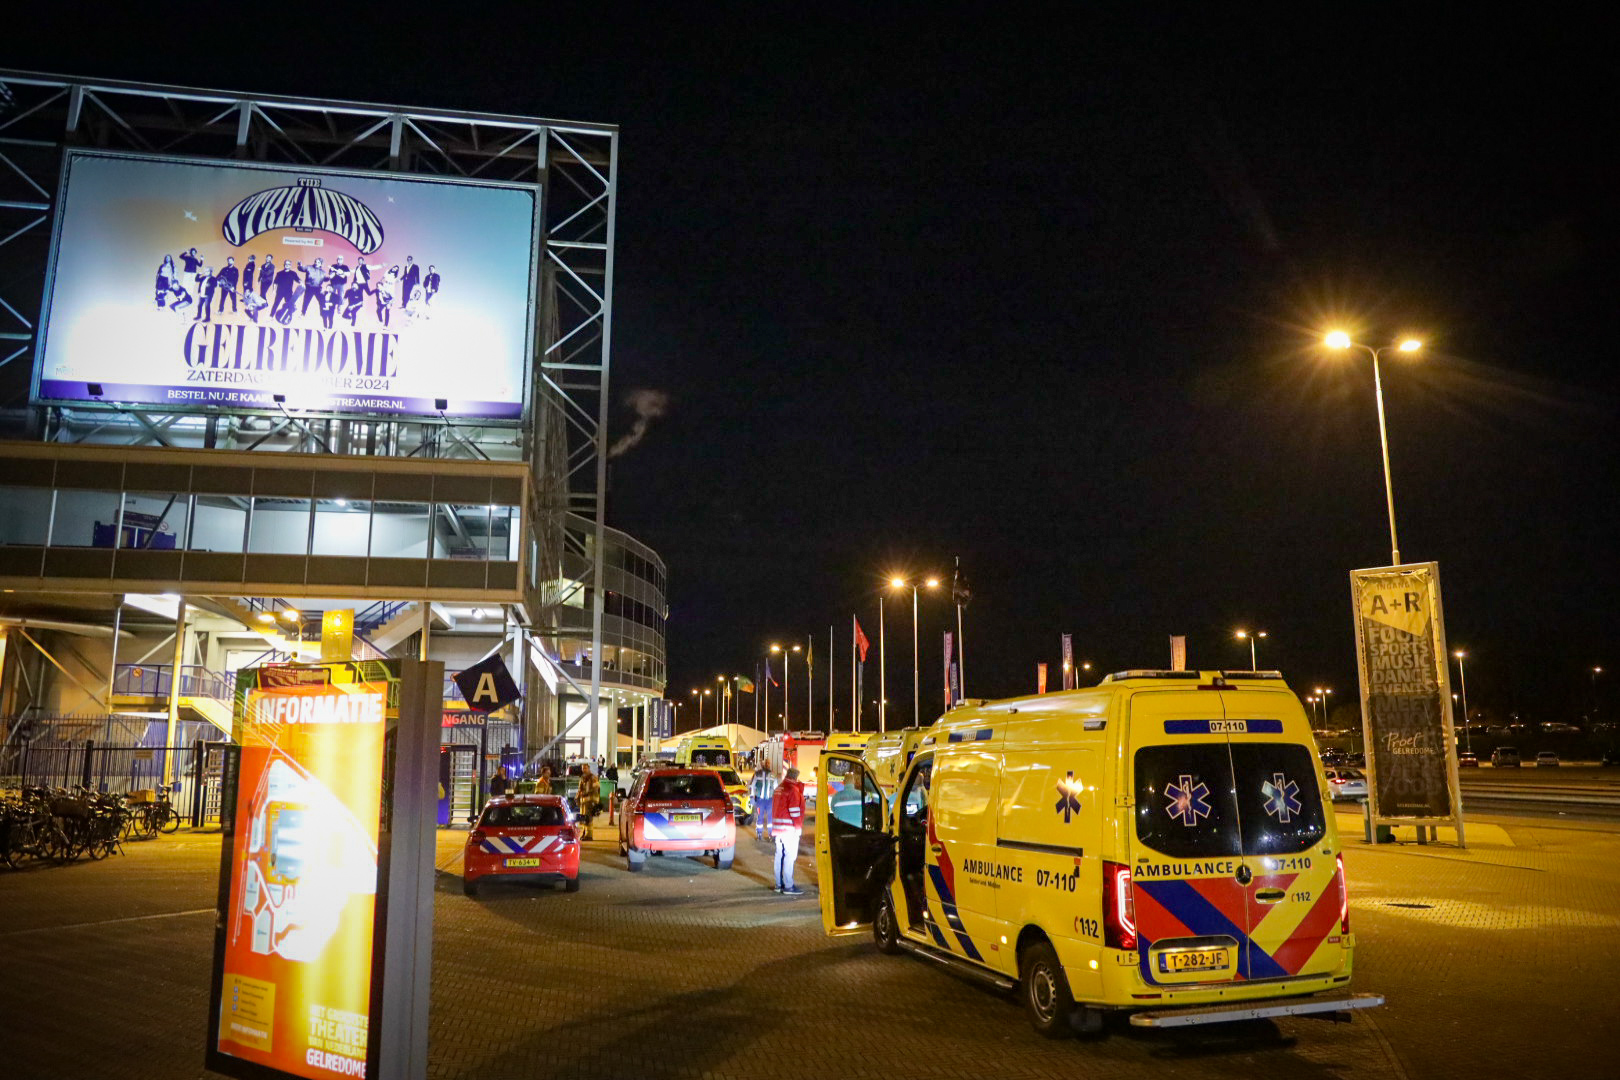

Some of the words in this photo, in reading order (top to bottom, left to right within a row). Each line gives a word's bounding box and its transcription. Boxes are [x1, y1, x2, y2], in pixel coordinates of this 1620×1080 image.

[299, 178, 321, 187] THE
[223, 187, 383, 254] STREAMERS
[183, 321, 399, 378] GELREDOME
[355, 378, 390, 391] 2024
[167, 389, 207, 400] BESTEL
[208, 392, 225, 401] NU
[225, 392, 238, 401] JE
[1370, 641, 1429, 656] SPORTS
[1372, 653, 1431, 670] MUSIC
[1372, 668, 1432, 684] DANCE
[472, 672, 499, 703] A
[255, 693, 382, 724] INFORMATIE
[442, 713, 485, 725] NGANG
[1210, 722, 1245, 731] 07-110
[1381, 731, 1424, 752] Proef
[1393, 747, 1436, 755] GELREDOME
[508, 858, 537, 866] TV-634-V
[1134, 862, 1234, 877] AMBULANCE
[1271, 858, 1312, 871] 07-110
[963, 859, 1023, 883] AMBULANCE
[1036, 869, 1076, 892] 07-110
[1171, 952, 1222, 967] T-282-JF
[310, 1018, 368, 1048] THEATER
[306, 1047, 367, 1079] GELREDOME
